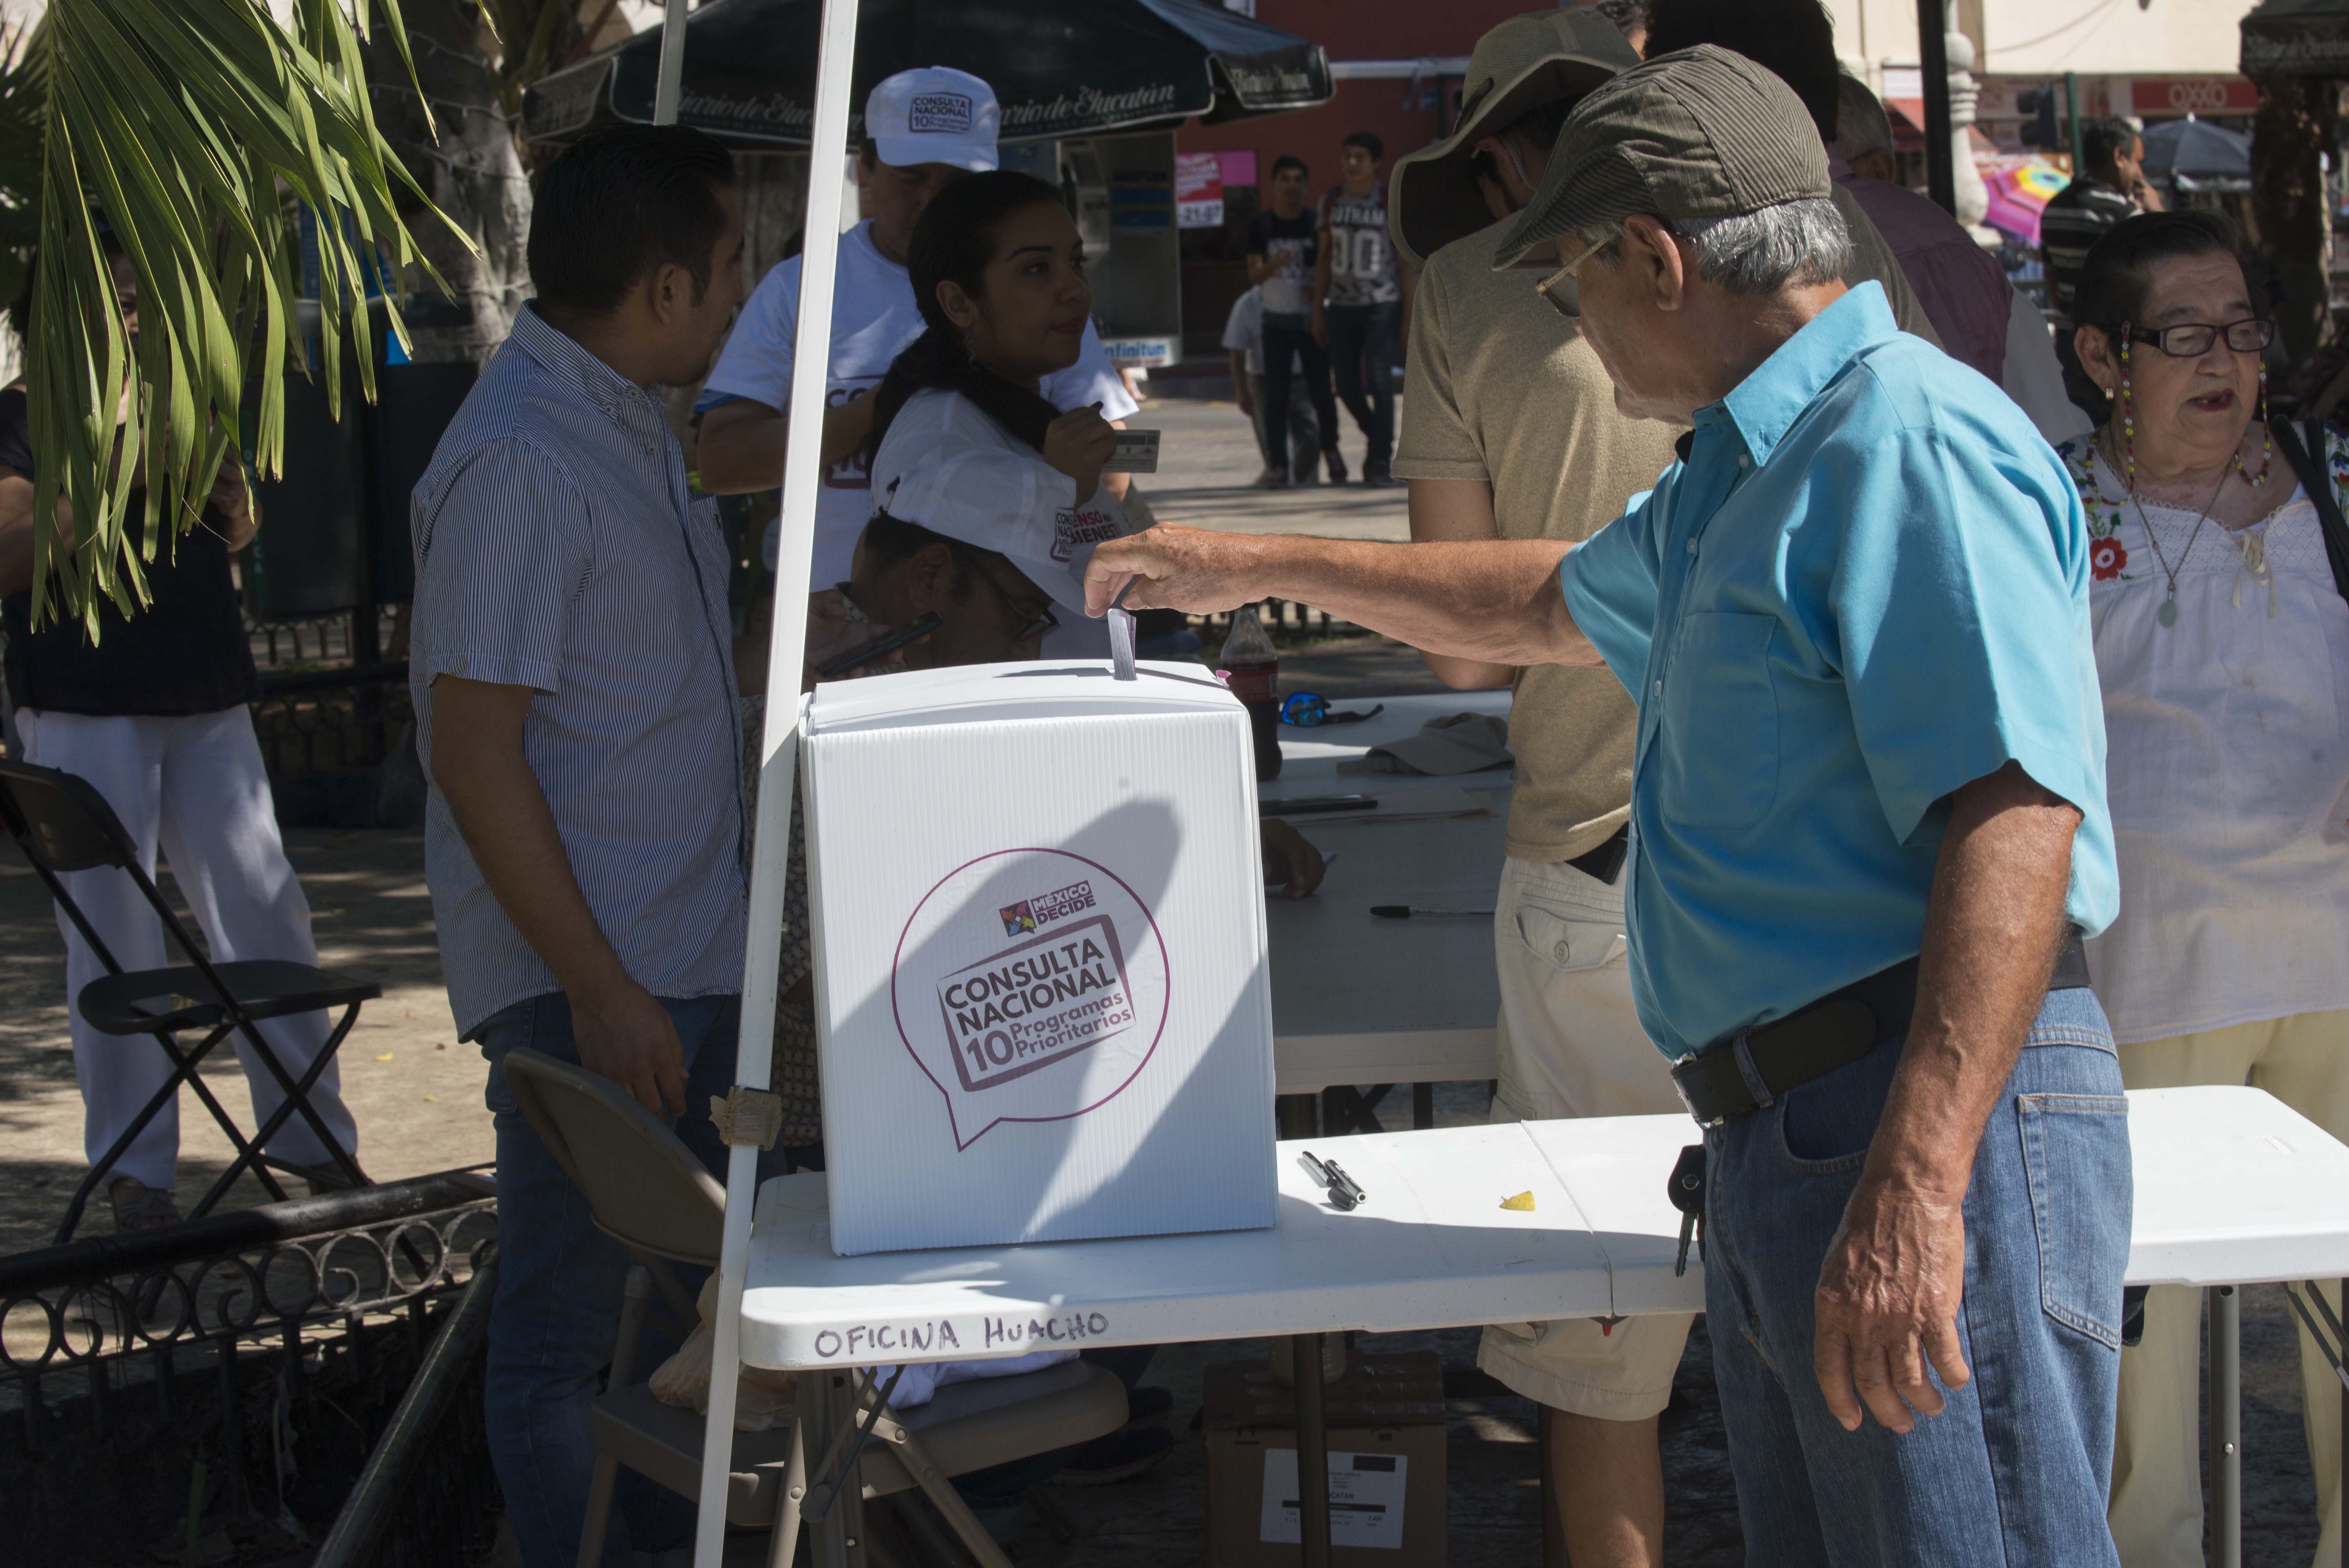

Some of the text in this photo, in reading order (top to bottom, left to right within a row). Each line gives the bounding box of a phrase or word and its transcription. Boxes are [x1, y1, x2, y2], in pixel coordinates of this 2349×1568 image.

[914, 97, 966, 108] CONSULTA
[2169, 82, 2227, 108] OXXO
[915, 106, 967, 118] NACIONAL
[915, 116, 929, 127] 10
[1000, 98, 1043, 127] ario
[1104, 342, 1166, 357] nfinitum
[1073, 511, 1103, 528] ENSO
[1036, 894, 1096, 925] DECIDE
[945, 938, 1105, 1009] CONSULTA
[956, 962, 1116, 1037] NACIONAL
[966, 992, 1123, 1072] 10 Programas
[1015, 1009, 1131, 1058] Prioritarios
[814, 1312, 1109, 1358] OFICINA HUACHO
